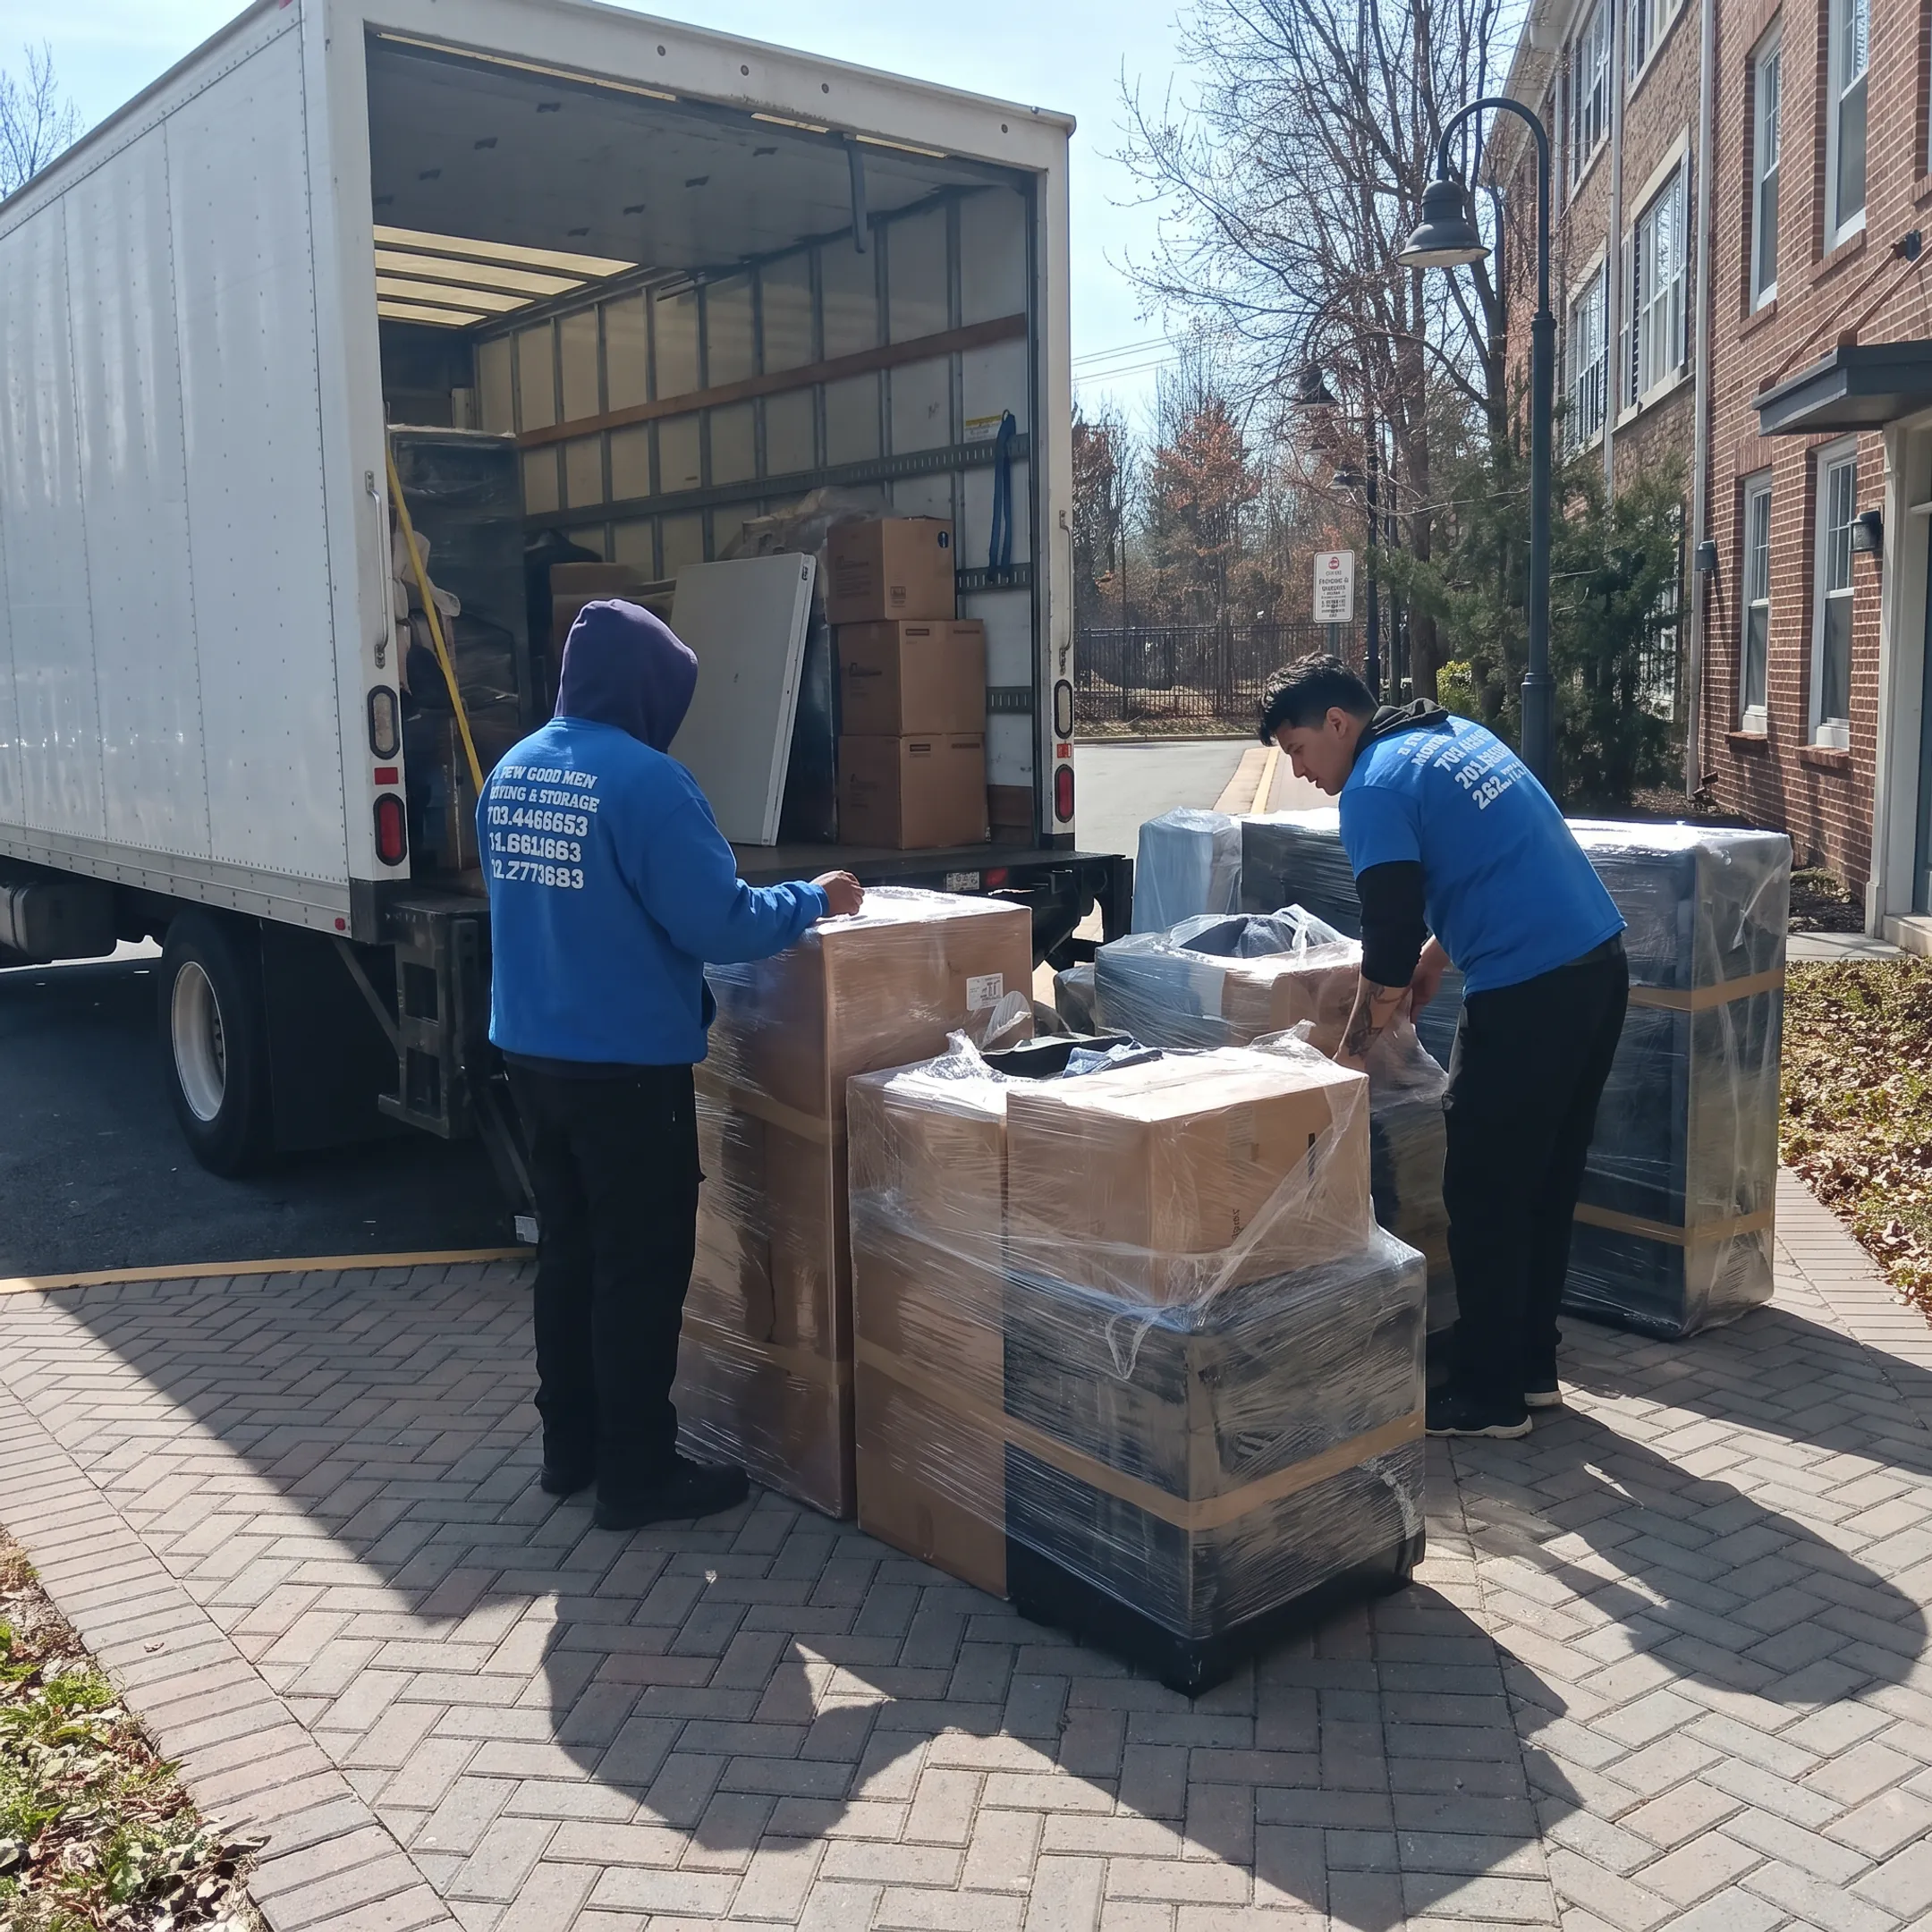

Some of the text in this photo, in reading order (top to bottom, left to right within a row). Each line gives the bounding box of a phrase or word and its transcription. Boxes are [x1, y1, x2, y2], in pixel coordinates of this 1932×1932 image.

[526, 767, 563, 784] GOOD
[562, 770, 598, 790] MEN
[528, 791, 538, 802] &
[538, 790, 600, 814] STORAGE
[487, 806, 589, 837] 703.4466653
